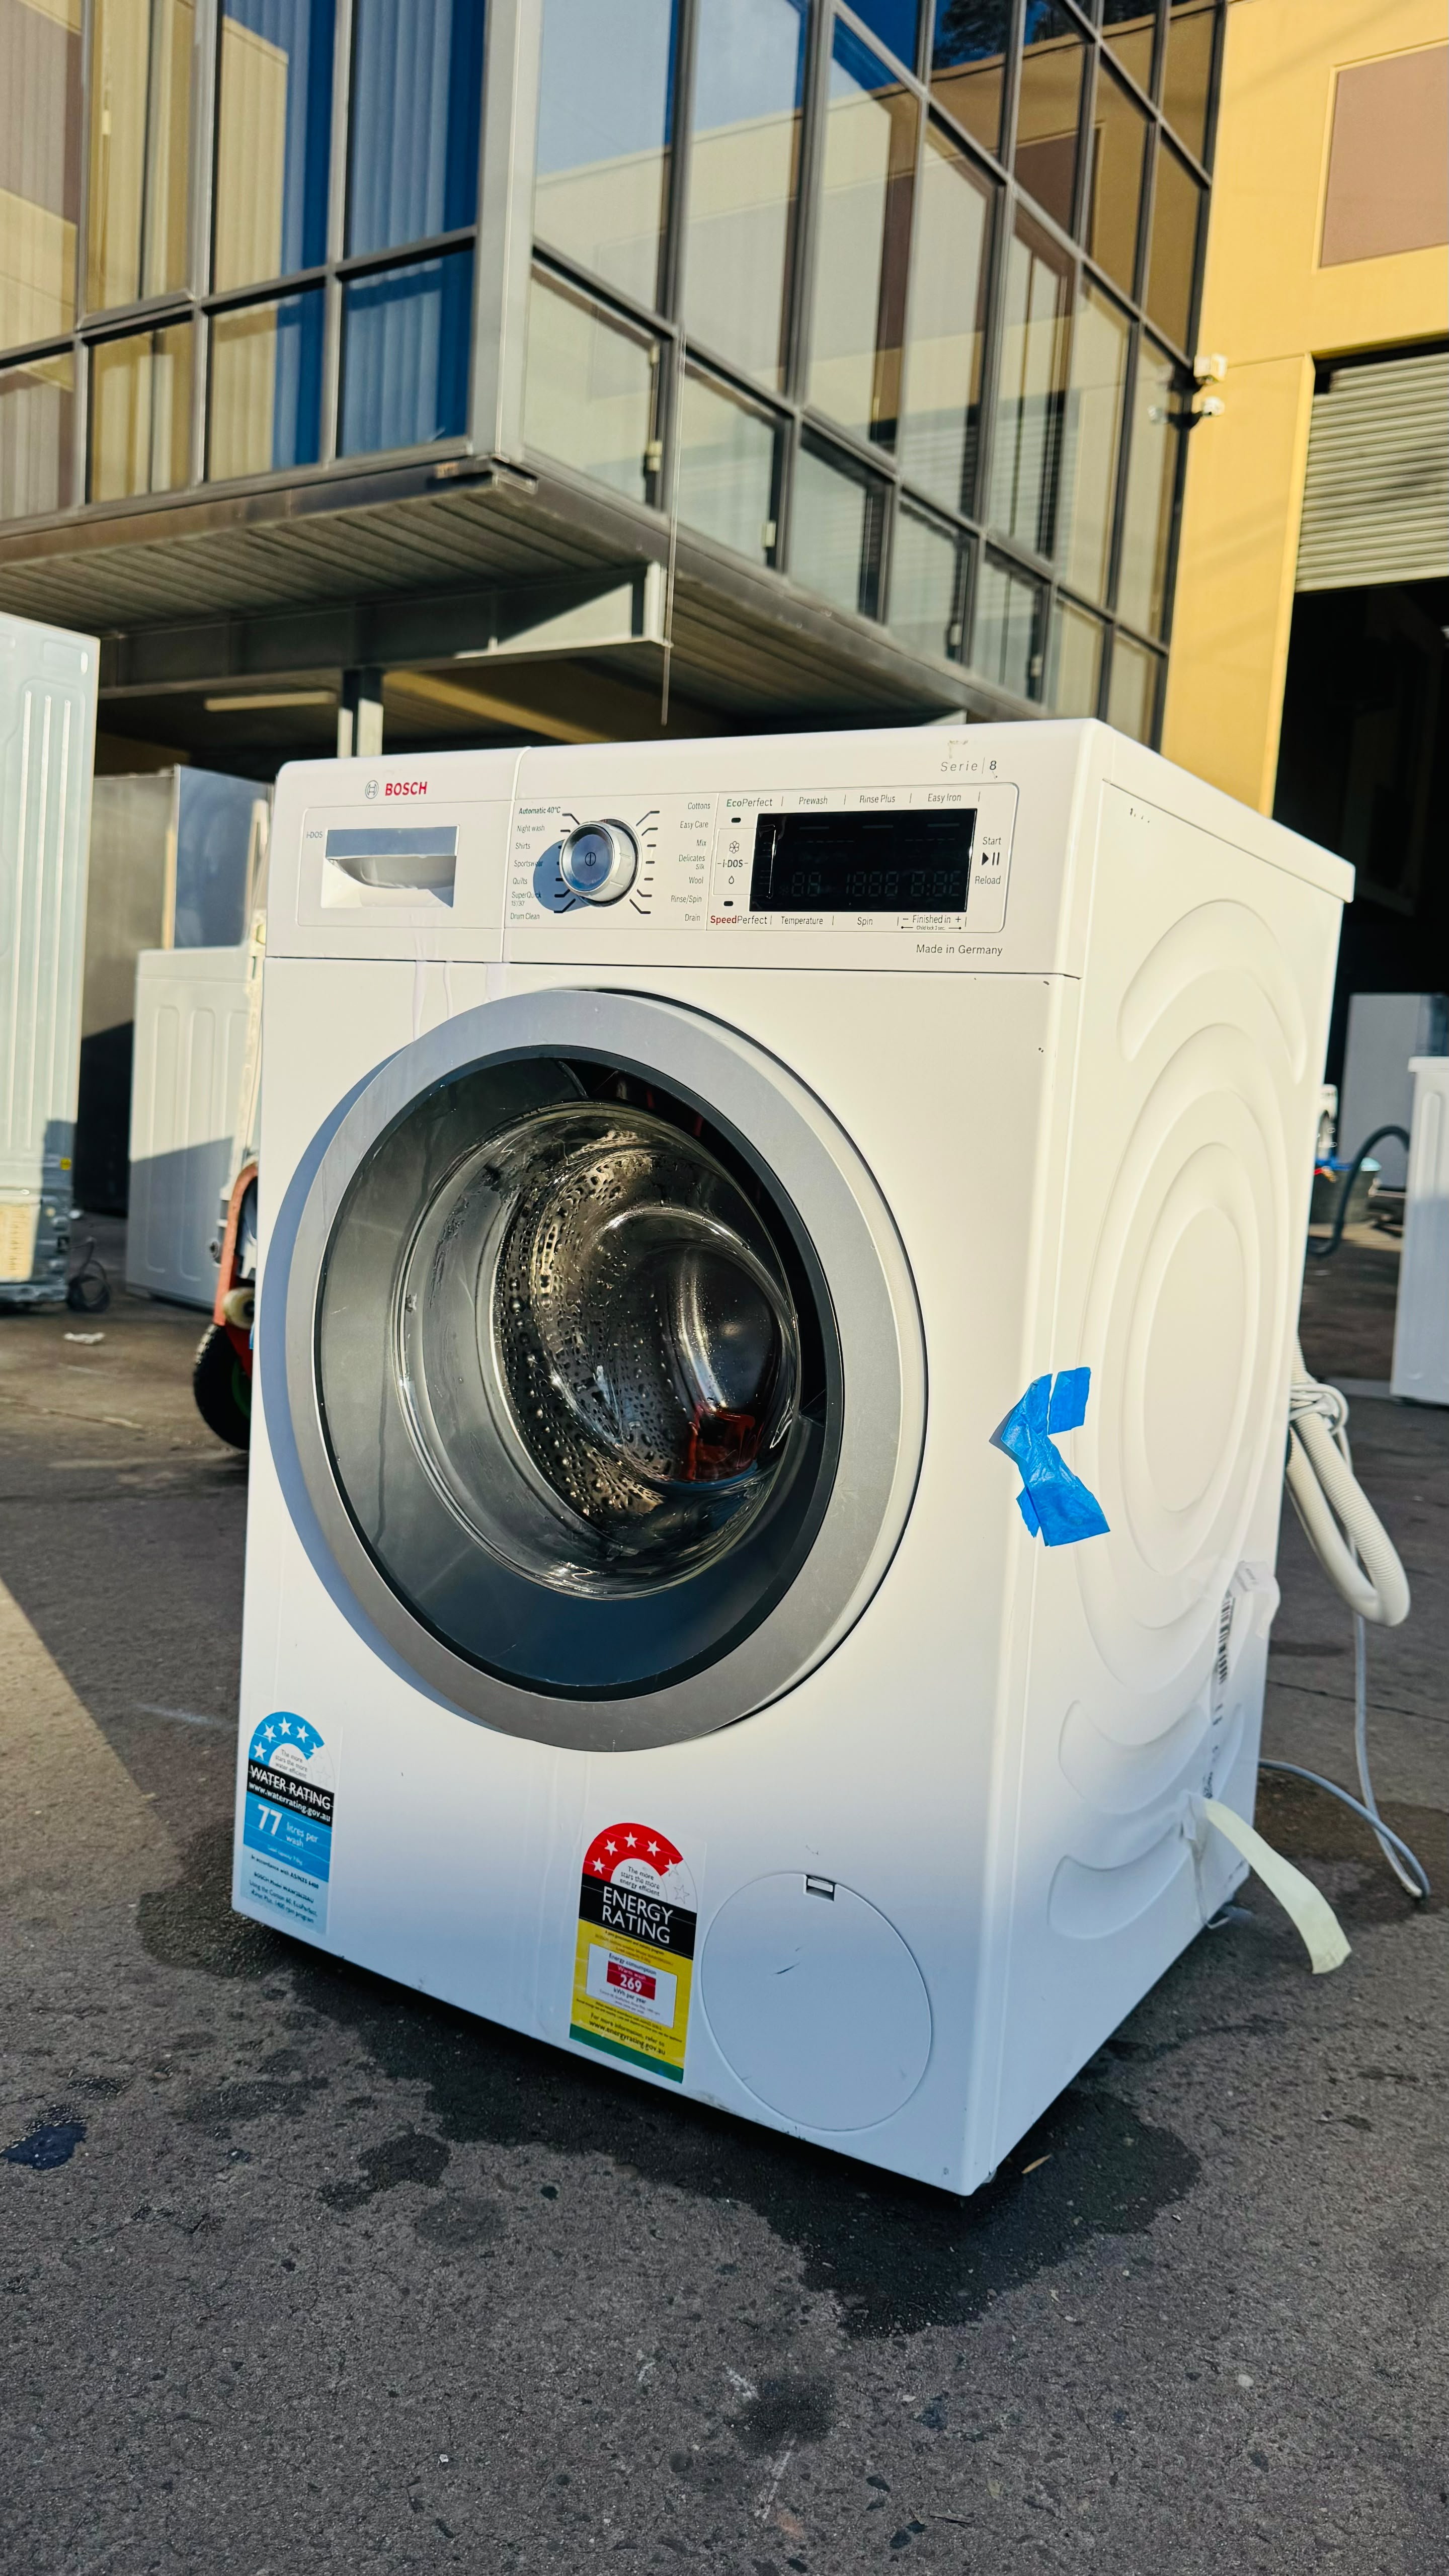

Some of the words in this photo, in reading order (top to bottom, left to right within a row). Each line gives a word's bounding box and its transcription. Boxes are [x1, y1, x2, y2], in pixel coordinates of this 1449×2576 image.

[941, 761, 978, 772] Serie
[990, 761, 997, 770] 8
[385, 781, 427, 796] BOSCH
[727, 798, 772, 807] EcoPerfect
[799, 796, 827, 804] Prewash
[860, 795, 878, 803] Rinse
[880, 794, 895, 803] Plus
[928, 794, 945, 802] Easy
[680, 821, 693, 829] Easy
[983, 837, 1001, 845] Start
[975, 876, 1001, 884] Reload
[671, 895, 702, 904] Rinse/Spin
[710, 916, 767, 925] SpeedPerfect
[781, 916, 823, 925] Temperature
[857, 917, 873, 926] Spin
[913, 915, 942, 923] Finished
[916, 944, 942, 953] Made
[946, 944, 954, 953] in
[958, 945, 1002, 956] Germany
[251, 1765, 286, 1792] WATER
[289, 1783, 331, 1810] RATING
[249, 1782, 331, 1821] www.waterrating.gov.au
[258, 1804, 283, 1836] 77
[628, 1866, 638, 1875] The
[639, 1872, 654, 1881] more
[621, 1872, 633, 1880] stars
[646, 1881, 660, 1889] more
[620, 1879, 637, 1890] energy
[639, 1885, 660, 1896] efficient
[603, 1886, 673, 1925] ENERGY
[602, 1905, 670, 1944] RATING
[620, 1974, 642, 1992] 269
